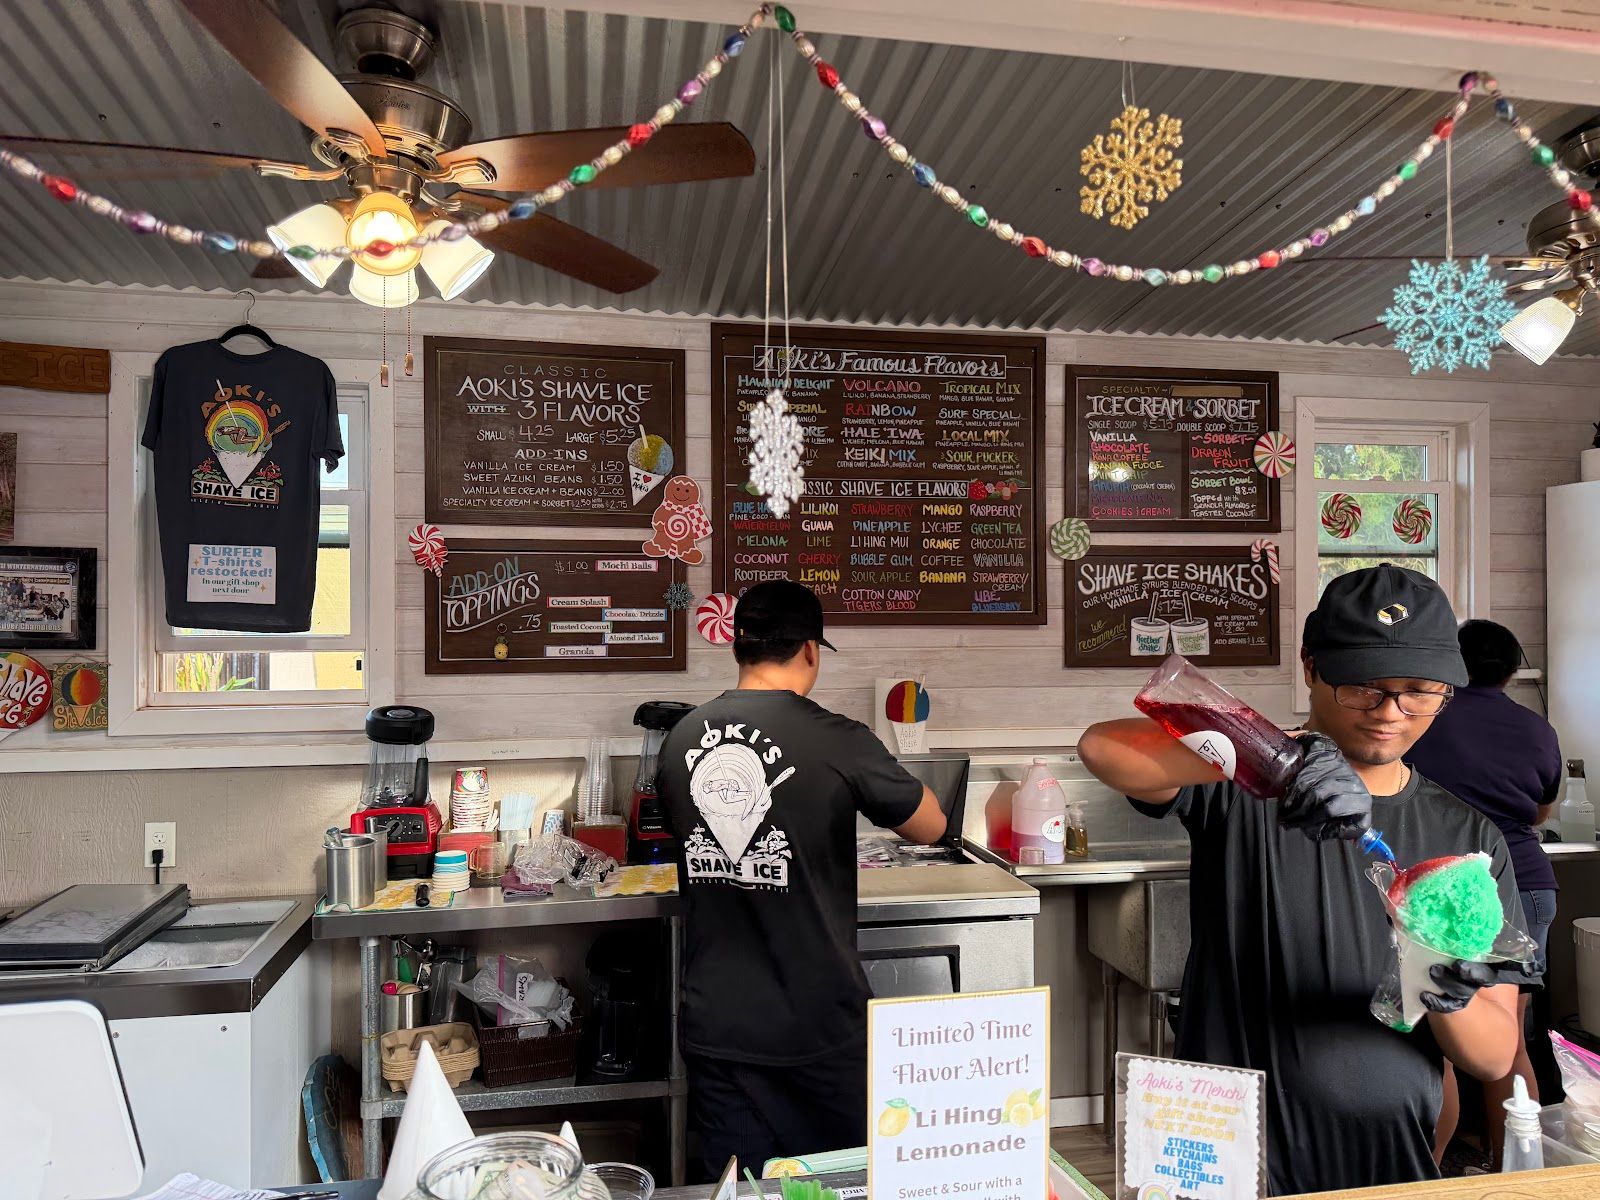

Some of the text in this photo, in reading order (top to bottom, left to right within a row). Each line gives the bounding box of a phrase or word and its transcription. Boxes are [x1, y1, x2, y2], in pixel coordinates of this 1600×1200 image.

[27, 351, 105, 387] ICE
[837, 352, 1004, 376] Famous Flavors
[504, 365, 607, 378] CLASSIC
[794, 379, 834, 389] DELIGHT
[843, 379, 921, 392] VOLCANO
[939, 381, 1022, 394] TROPICAL MIX
[1102, 386, 1160, 394] SPECIALTY
[456, 376, 653, 405] AOKI'S SHAVE ICE
[467, 401, 640, 427] WITH 3 FLAVORS
[845, 403, 916, 416] RAINBOW
[939, 408, 1021, 419] SURF SPECIAL
[1085, 395, 1260, 422] ICE CREAM SORBET
[1088, 420, 1110, 429] SINGLE
[1176, 422, 1225, 432] DOUBLE SCOOP
[477, 430, 506, 441] SMALL
[566, 432, 597, 443] LARGE
[840, 427, 880, 438] HALE
[942, 430, 1009, 442] LOCAL MIX
[1089, 431, 1137, 442] VANILLA
[1203, 433, 1247, 444] SORBET
[1090, 442, 1151, 453] CHOCOLATE
[514, 449, 588, 460] ADD-INS
[845, 447, 916, 463] KEIKI MIX
[946, 450, 1016, 463] SOUR PUCKER
[1092, 452, 1148, 461] KONA COFFEE
[464, 461, 508, 470] VANILLA
[514, 463, 532, 471] ICE
[1132, 461, 1164, 469] FUDGE
[1213, 458, 1251, 468] FRUIT
[464, 474, 497, 482] SWEET
[504, 474, 536, 483] AZUKI
[544, 475, 582, 484] BEANS
[1191, 476, 1253, 488] SORBET BOWL
[193, 482, 276, 500] SHAVE ICE
[463, 486, 549, 495] VANILLA CREAM
[840, 481, 966, 497] SHAVE ICE FLAVORS
[1235, 486, 1256, 495] $8.50
[443, 498, 487, 506] SPECIALTY
[800, 502, 839, 515] LILIKOI
[852, 502, 913, 516] STRAWBERRY
[923, 504, 962, 515] MANGO
[970, 504, 1022, 518] RASPBERRY
[1092, 507, 1170, 516] COOKIES CREAM
[734, 522, 790, 530] WATERMELON
[802, 520, 834, 532] GUAVA
[853, 520, 911, 533] PINEAPPLE
[921, 522, 962, 533] LYCHEE
[971, 523, 1022, 535] GREEN TEA
[738, 535, 789, 546] MELONA
[807, 536, 831, 547] LIME
[851, 536, 909, 548] LI HING MUI
[923, 538, 960, 549] ORANGE
[971, 538, 1026, 549] CHOCOLATE
[202, 546, 262, 557] SURFER
[202, 557, 261, 567] T-shirts
[734, 553, 789, 564] COCONUT
[798, 553, 840, 564] CHERRY
[850, 554, 913, 566] BUBBLE GUM
[921, 555, 964, 566] COFFEE
[973, 554, 1024, 566] VANILLA
[601, 561, 652, 570] Mochi Balls
[191, 568, 272, 577] restocked!
[449, 557, 519, 596] ADD-ON
[735, 568, 793, 582] ROOTBEER
[800, 568, 840, 581] LEMON
[852, 570, 912, 584] SOUR APPLE
[920, 571, 966, 583] BANANA
[1078, 563, 1267, 600] SHAVE ICE SHAKES
[992, 584, 1024, 592] CREAM
[443, 574, 540, 627] TOPPINGS
[842, 588, 921, 601] COTTON CANDY
[975, 591, 1000, 602] UBE
[1083, 598, 1100, 608] OUR
[1100, 584, 1139, 603] HOMEMADE
[1142, 581, 1168, 590] SYRUPS
[1172, 581, 1208, 593] BLENDED
[1107, 589, 1229, 609] VANILLA ICE CREAM
[582, 598, 607, 606] Splash
[843, 601, 916, 611] TIGERS BLOOD
[1079, 614, 1127, 651] recommend
[685, 722, 782, 772] AOKI'S
[754, 864, 782, 879] ICE
[892, 1020, 1032, 1047] Limited Time
[893, 1054, 1029, 1084] Flavor Alert!
[1137, 1072, 1248, 1100] Aoki's Merch!
[916, 1106, 1002, 1128] Li Hing
[896, 1135, 1026, 1162] Lemonade
[1168, 1137, 1214, 1153] STICKERS
[1163, 1146, 1218, 1163] KEYCHAINS
[1178, 1159, 1203, 1171] BAGS
[1155, 1164, 1224, 1184] COLLECTIBLES
[899, 1186, 937, 1198] Sweet
[941, 1184, 949, 1194] &
[953, 1182, 982, 1192] Sour
[985, 1176, 1011, 1188] with
[1180, 1180, 1200, 1191] ART
